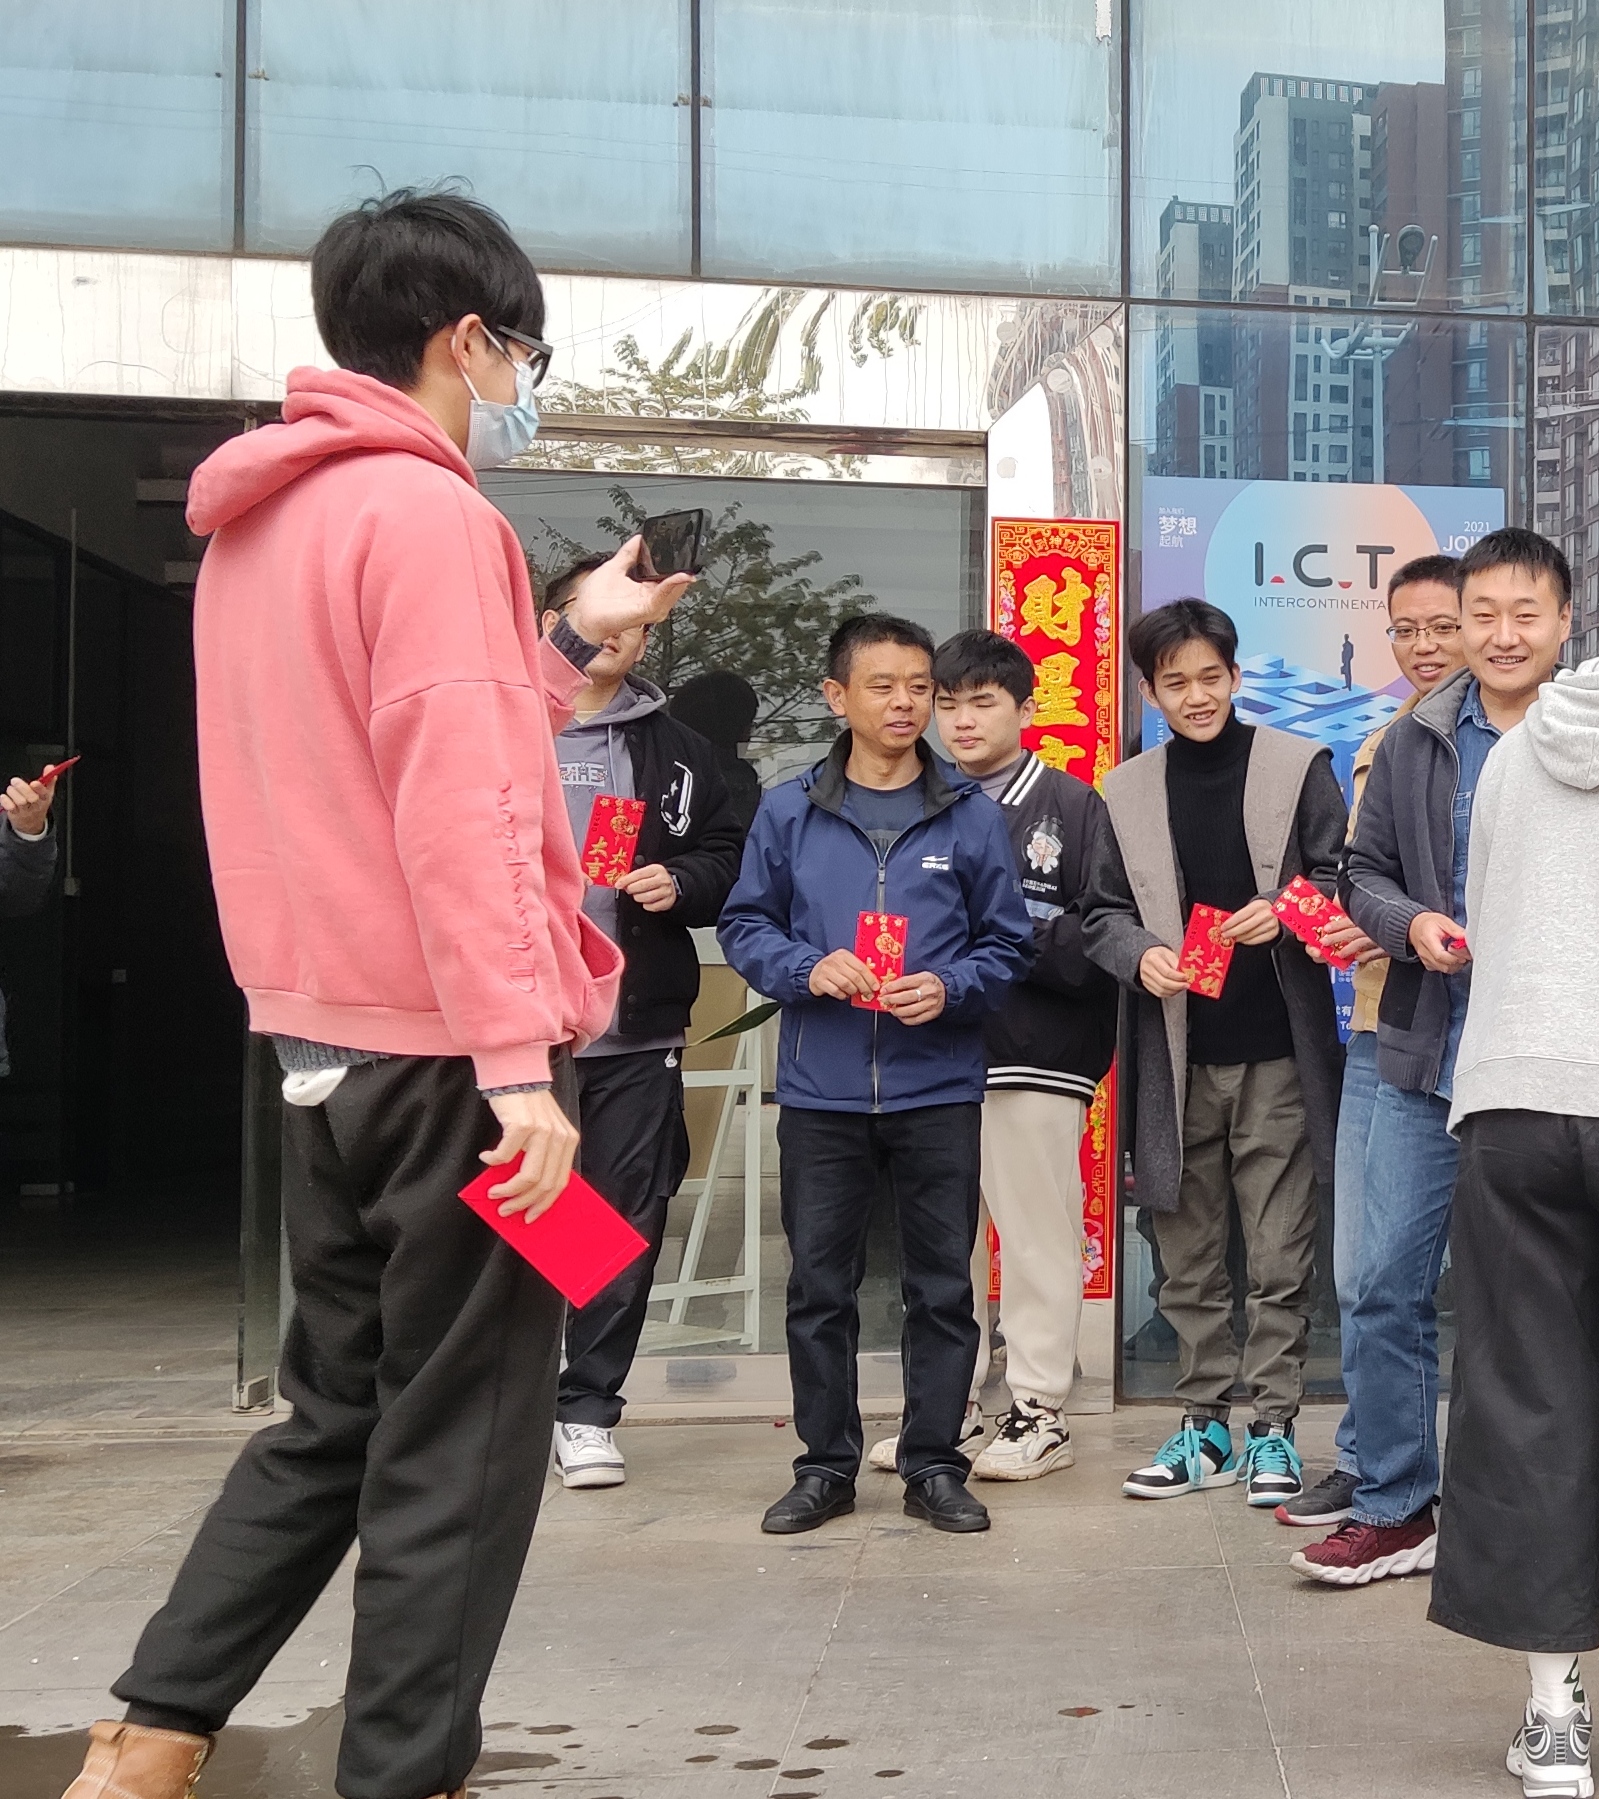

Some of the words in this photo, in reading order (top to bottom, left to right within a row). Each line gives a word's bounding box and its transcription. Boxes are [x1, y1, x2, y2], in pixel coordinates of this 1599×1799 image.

[1158, 515, 1197, 535] 梦想
[1464, 520, 1491, 533] 2021
[1442, 534, 1481, 552] JOI
[1254, 596, 1387, 611] INTERCONTINENTA
